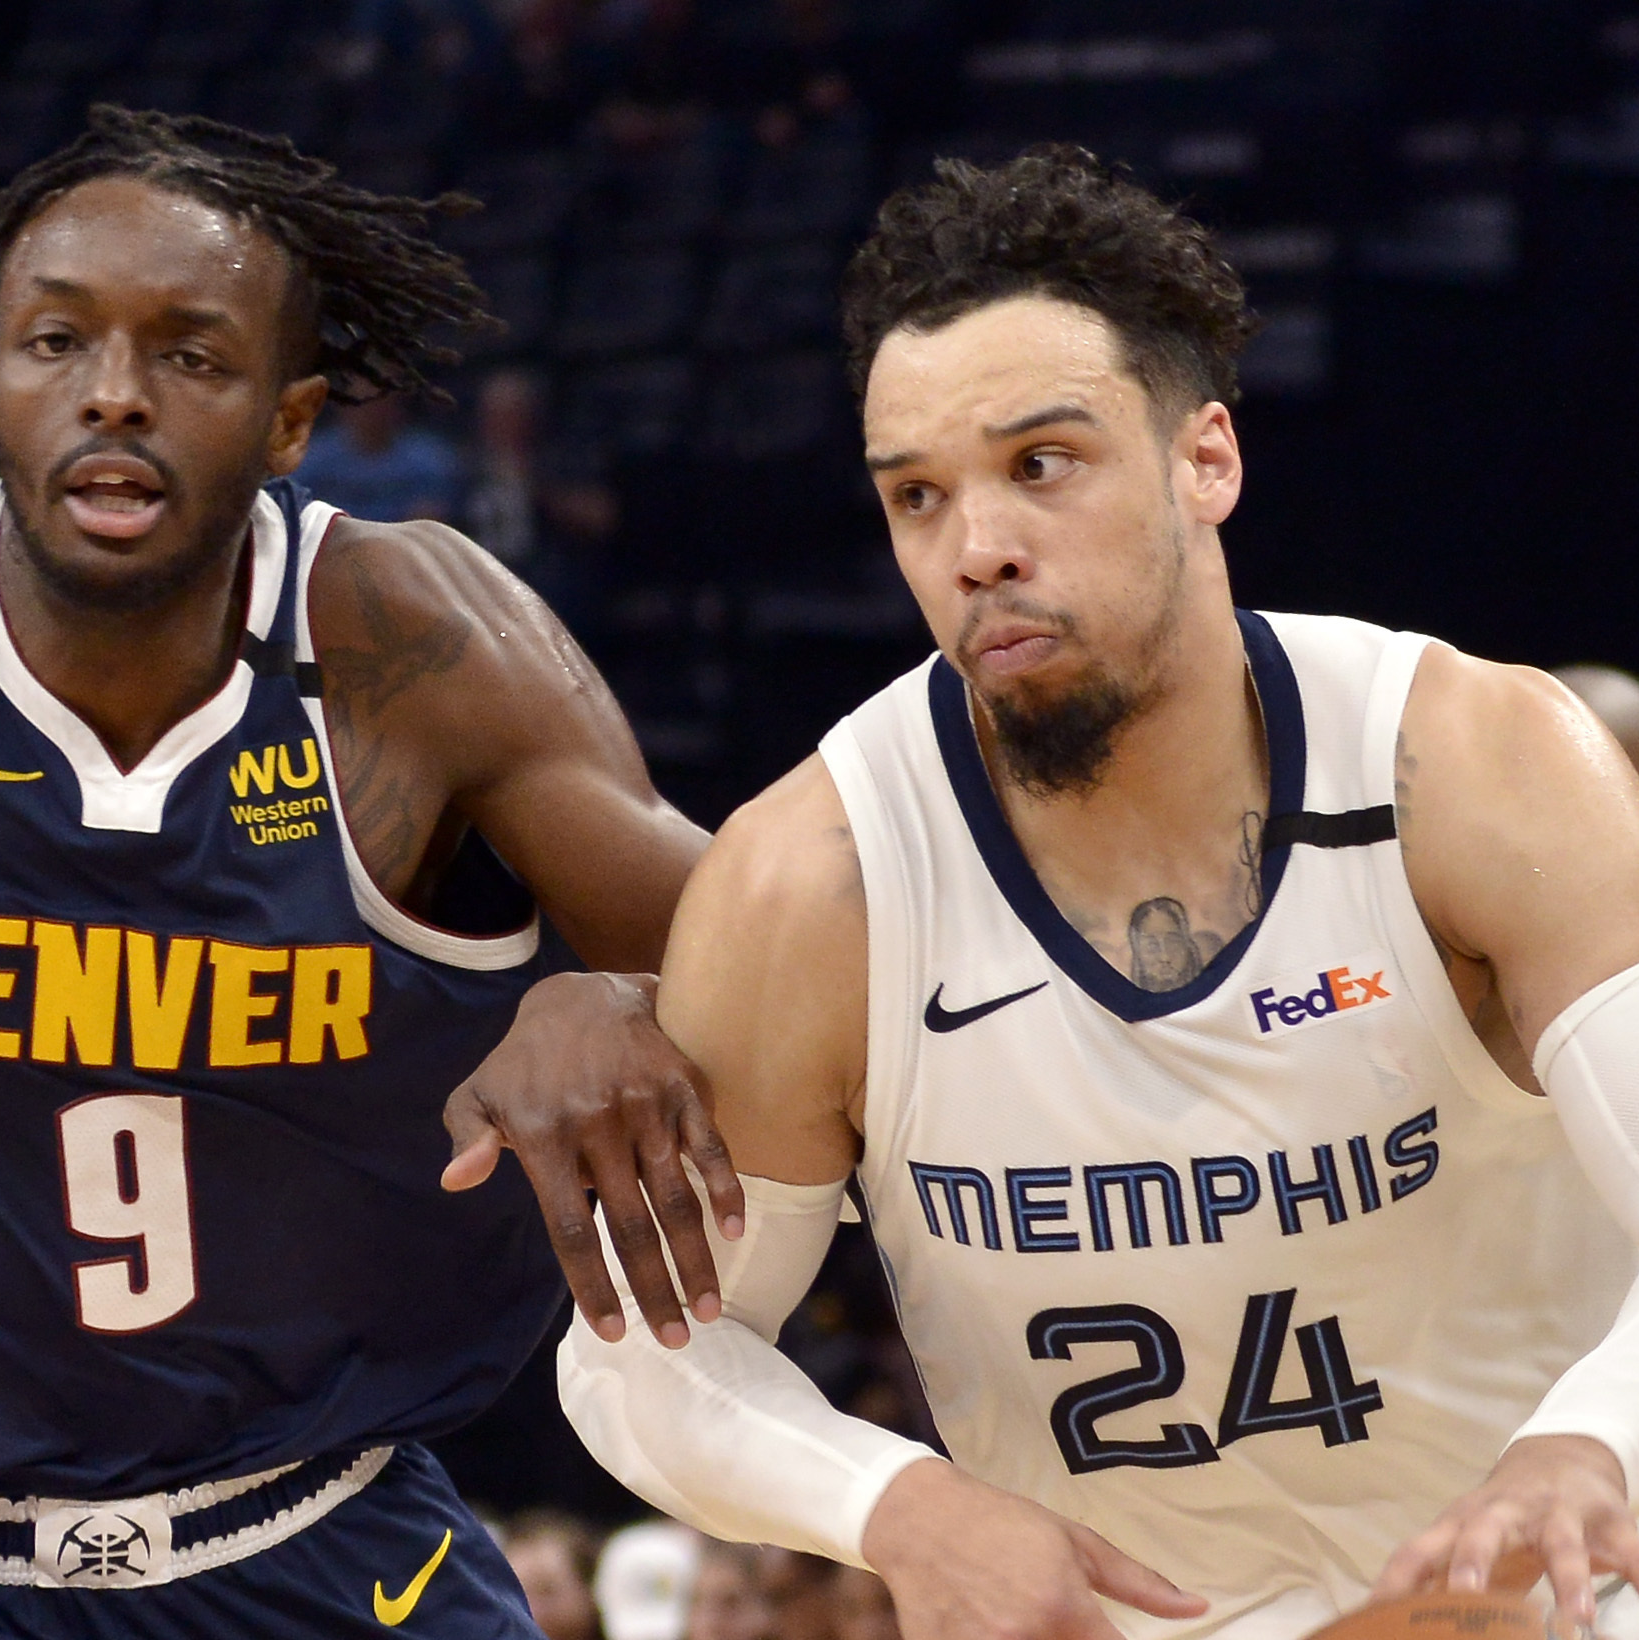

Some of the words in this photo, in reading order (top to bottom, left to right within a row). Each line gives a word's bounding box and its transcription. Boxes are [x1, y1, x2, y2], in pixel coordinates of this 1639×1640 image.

[229, 738, 320, 798] WU
[229, 796, 328, 825] Western
[248, 819, 318, 845] Union
[1249, 966, 1393, 1034] FedEx
[55, 1090, 198, 1335] 9
[907, 1105, 1440, 1254] MEMPHIS
[1025, 1287, 1384, 1476] 24
